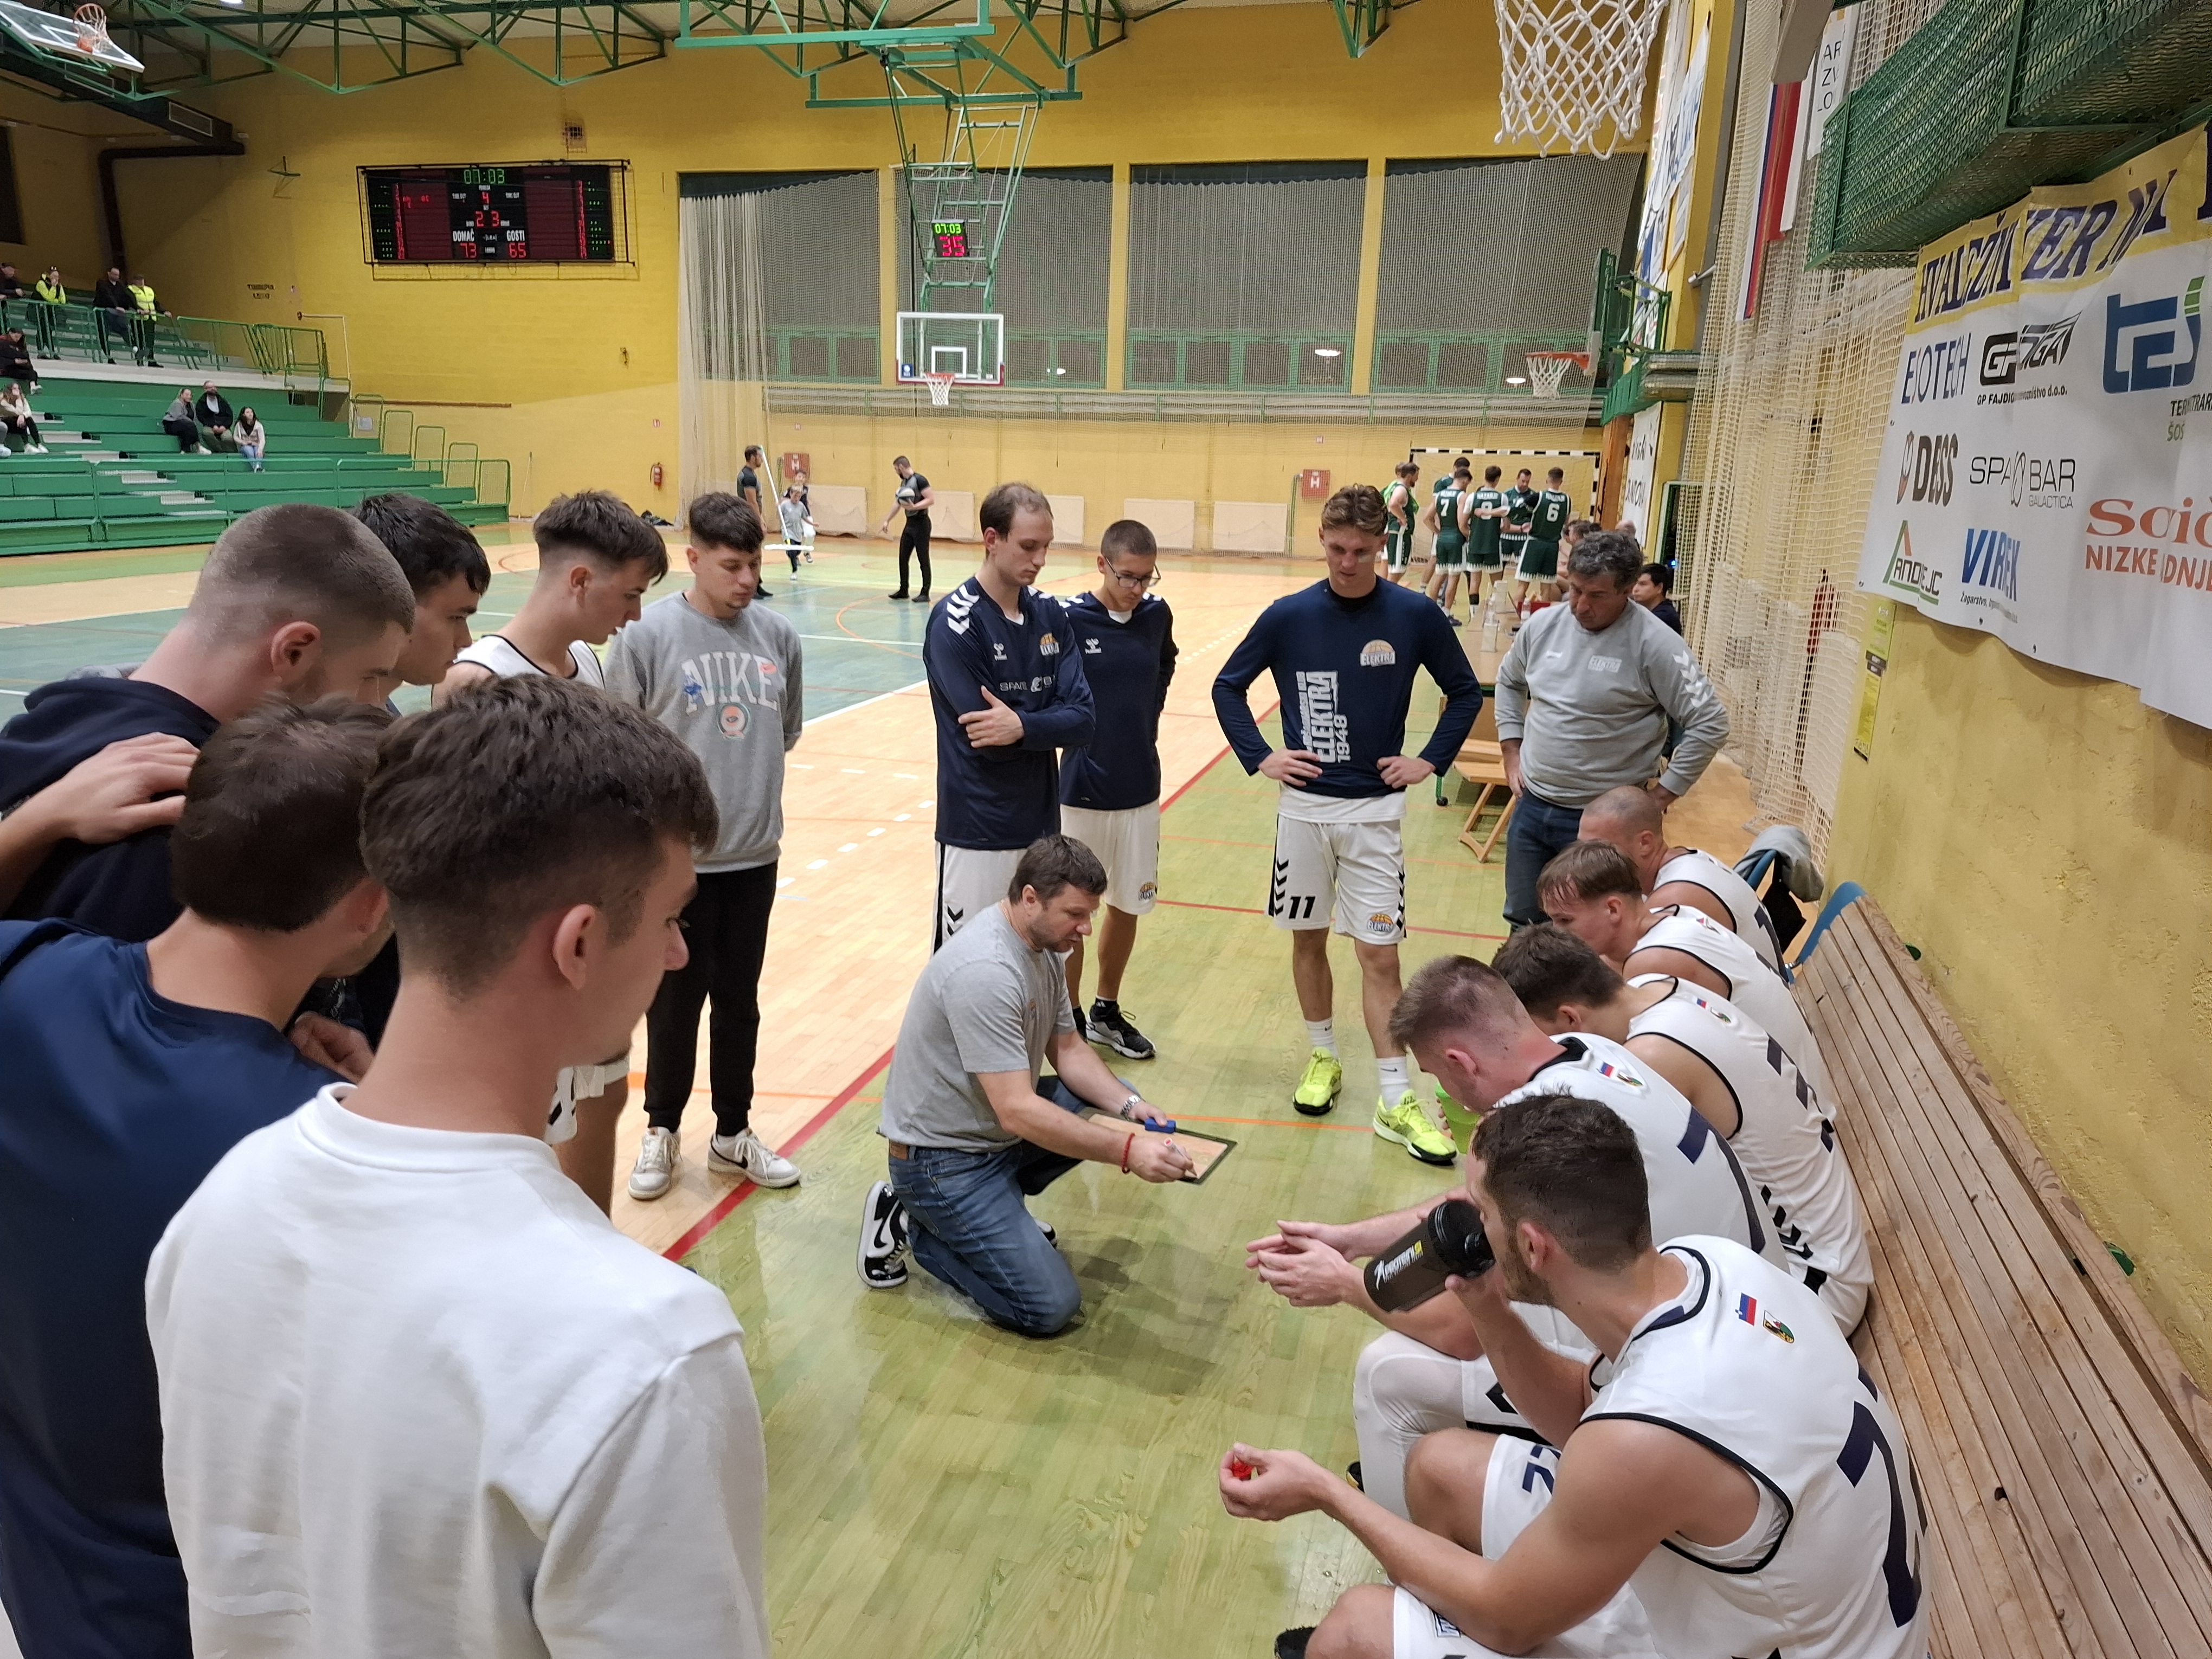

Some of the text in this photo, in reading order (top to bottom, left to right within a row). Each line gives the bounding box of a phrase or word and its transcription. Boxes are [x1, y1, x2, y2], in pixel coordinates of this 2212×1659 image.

[464, 169, 505, 185] 07:03
[482, 191, 489, 204] 4
[475, 210, 499, 227] 2 3
[506, 229, 525, 242] GOSTI
[935, 223, 961, 234] 07:03
[460, 242, 477, 258] 73
[509, 242, 526, 259] 65
[939, 236, 965, 256] 35
[1310, 477, 1320, 488] H
[2029, 458, 2076, 493] BAR
[1440, 498, 1450, 517] 7
[2028, 494, 2073, 509] GALACTICA
[1546, 503, 1560, 522] 6
[2085, 544, 2159, 575] NIZKE
[681, 651, 779, 715] NIKE
[1306, 671, 1338, 763] ELEKTRA
[1333, 714, 1351, 763] 1948
[1288, 895, 1316, 919] 11
